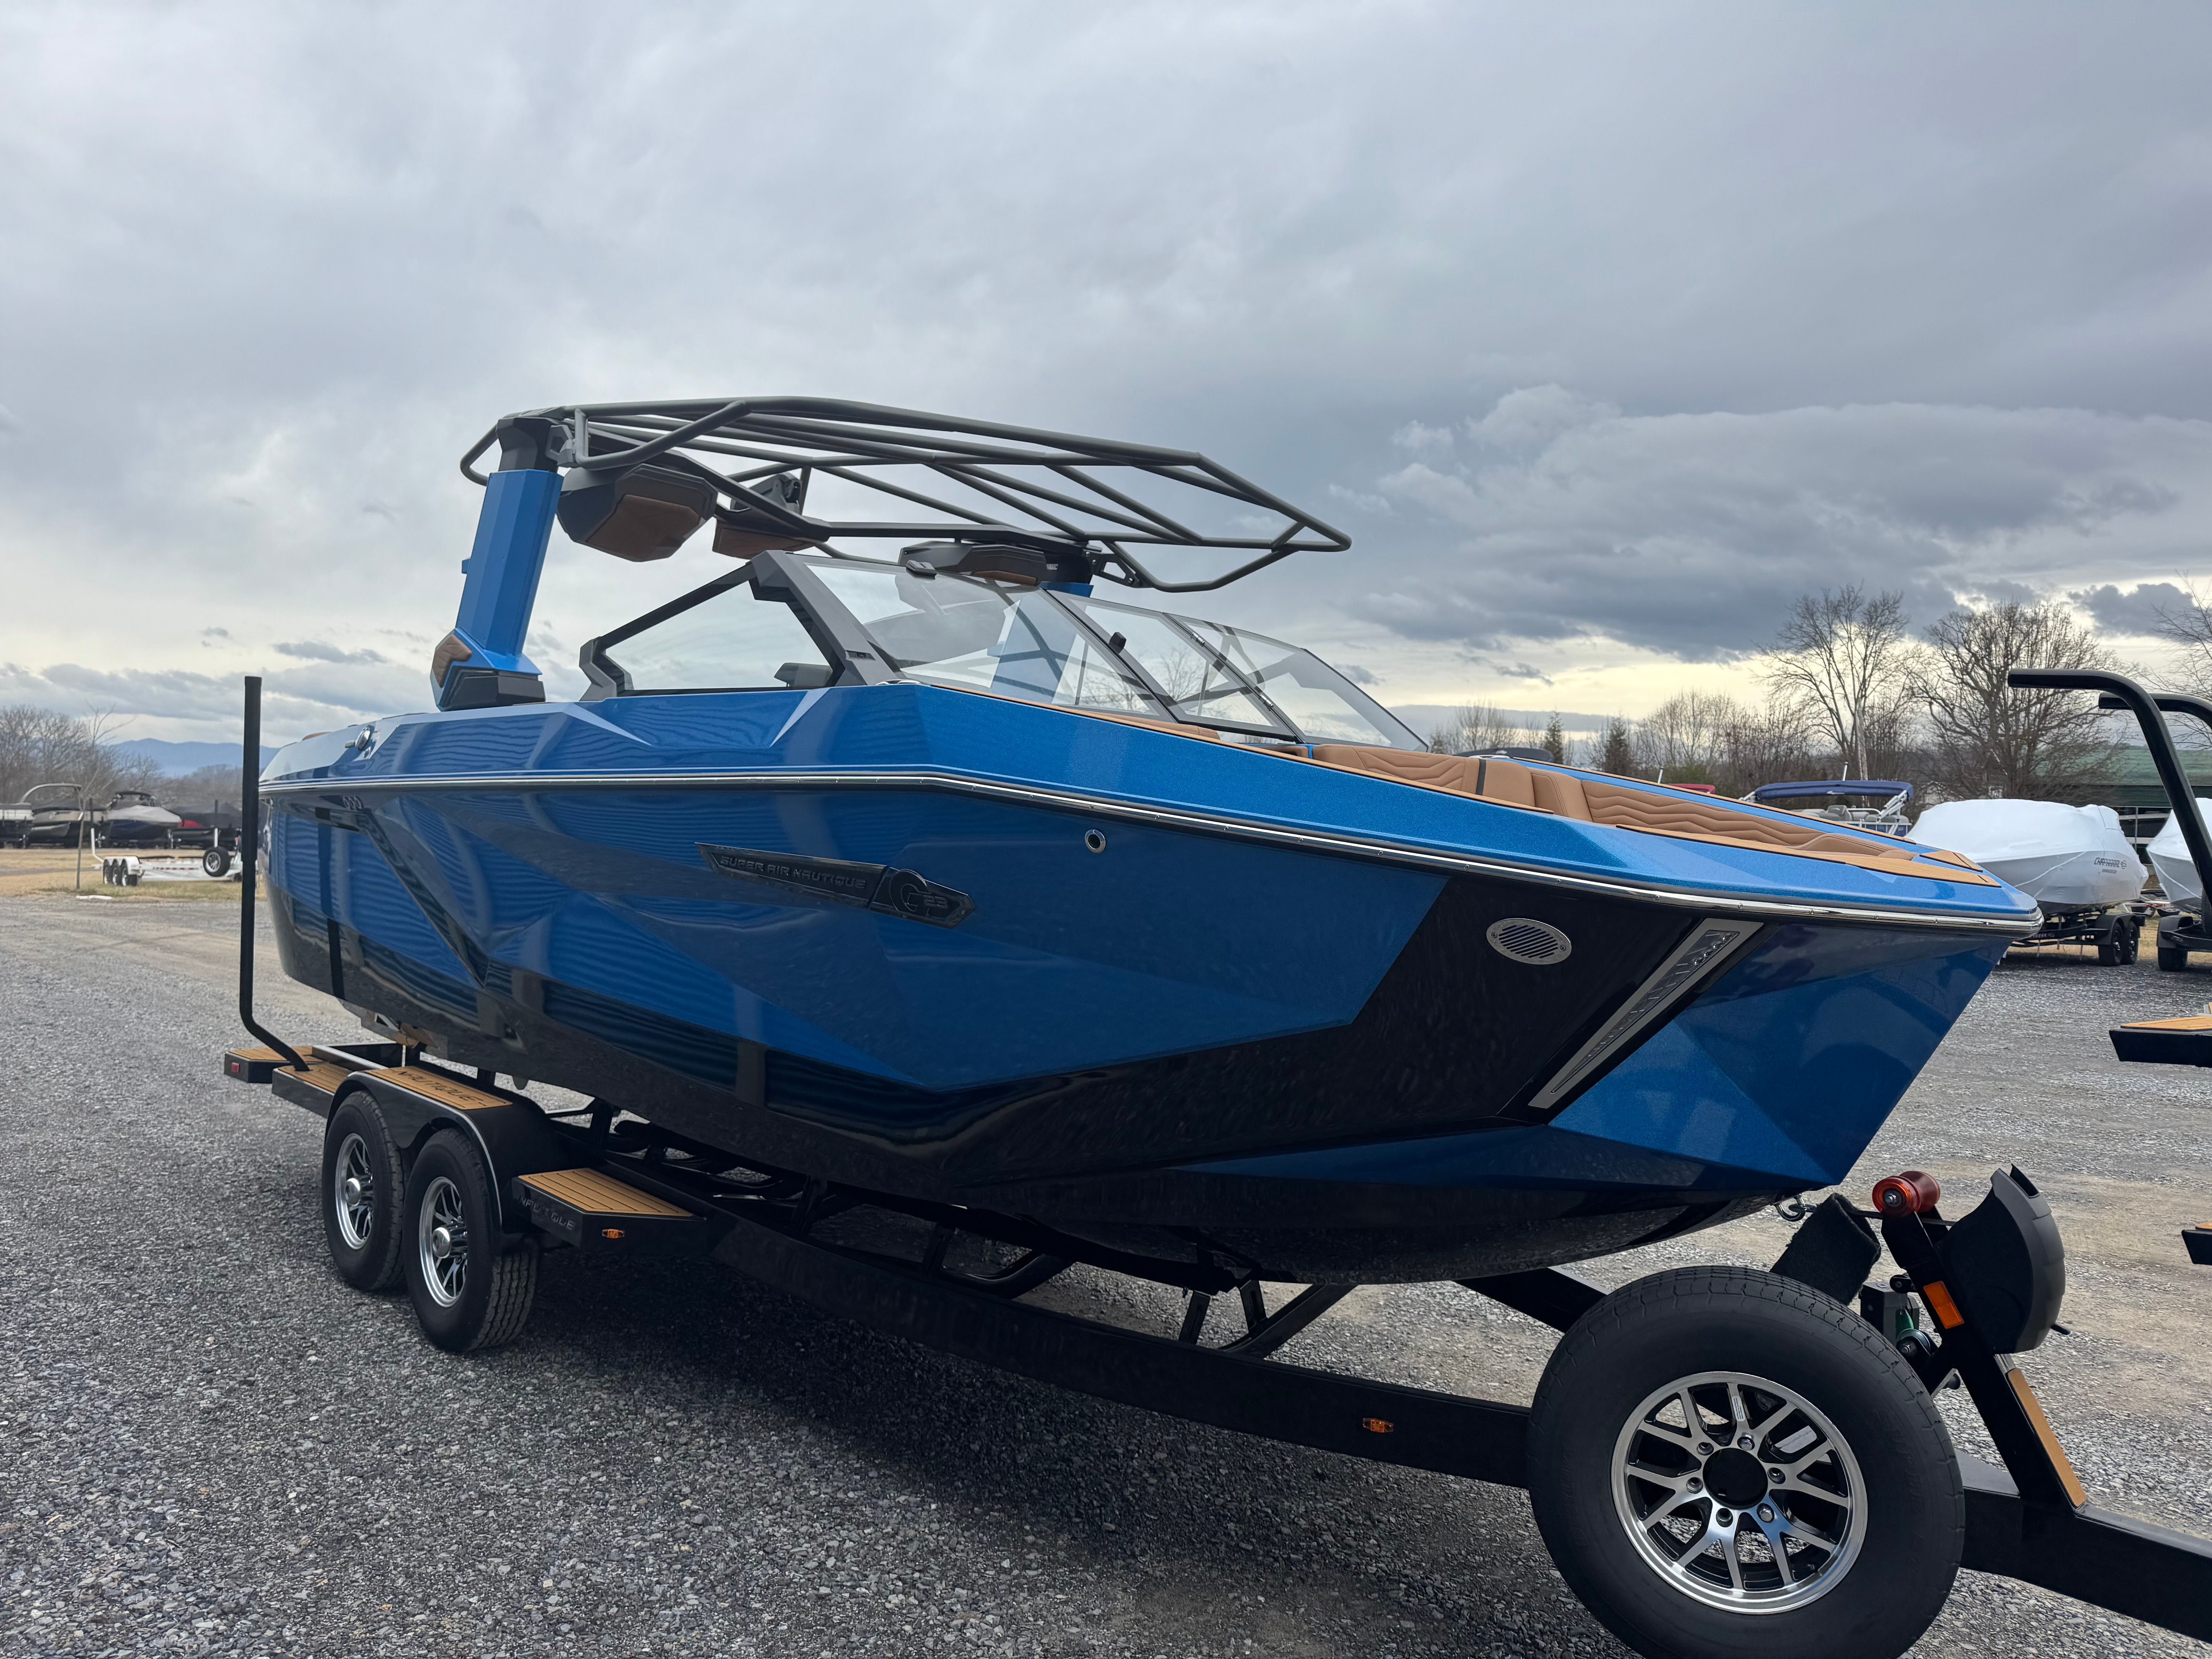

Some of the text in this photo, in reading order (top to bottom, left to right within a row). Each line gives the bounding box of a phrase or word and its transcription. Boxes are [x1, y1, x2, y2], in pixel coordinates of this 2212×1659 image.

[720, 856, 764, 871] SUPER
[767, 864, 790, 876] AIR
[793, 868, 867, 889] NAUTIQUE
